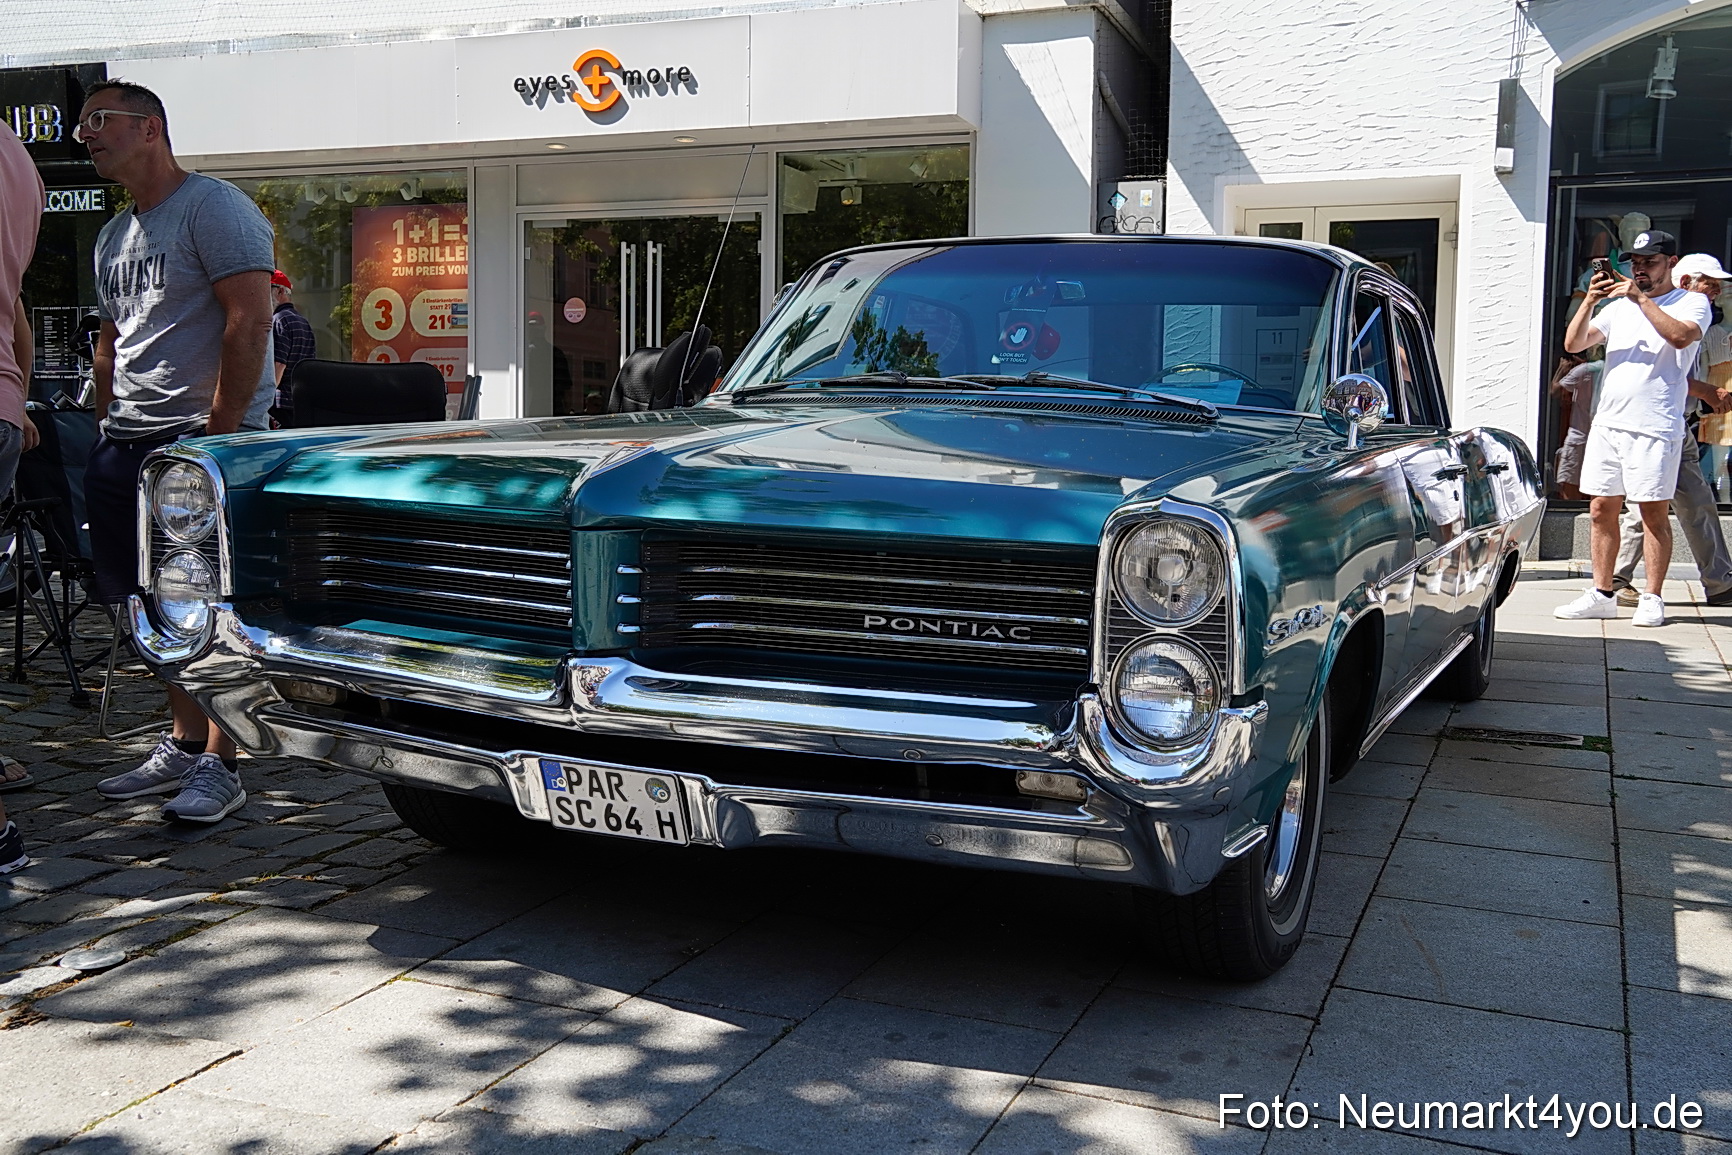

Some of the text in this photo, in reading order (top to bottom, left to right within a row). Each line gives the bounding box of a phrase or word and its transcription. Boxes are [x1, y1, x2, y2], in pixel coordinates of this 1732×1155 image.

[513, 74, 571, 98] eyes
[622, 66, 691, 86] more
[44, 190, 101, 211] COME
[392, 245, 468, 264] 3 BRILLE
[102, 252, 166, 301] HAVASU
[391, 264, 468, 276] ZUM PREIS VON
[374, 299, 393, 330] 3
[1272, 332, 1283, 345] 11
[863, 614, 1032, 640] PONTIAC
[562, 766, 628, 802] PAR
[555, 796, 679, 841] SC 64 H
